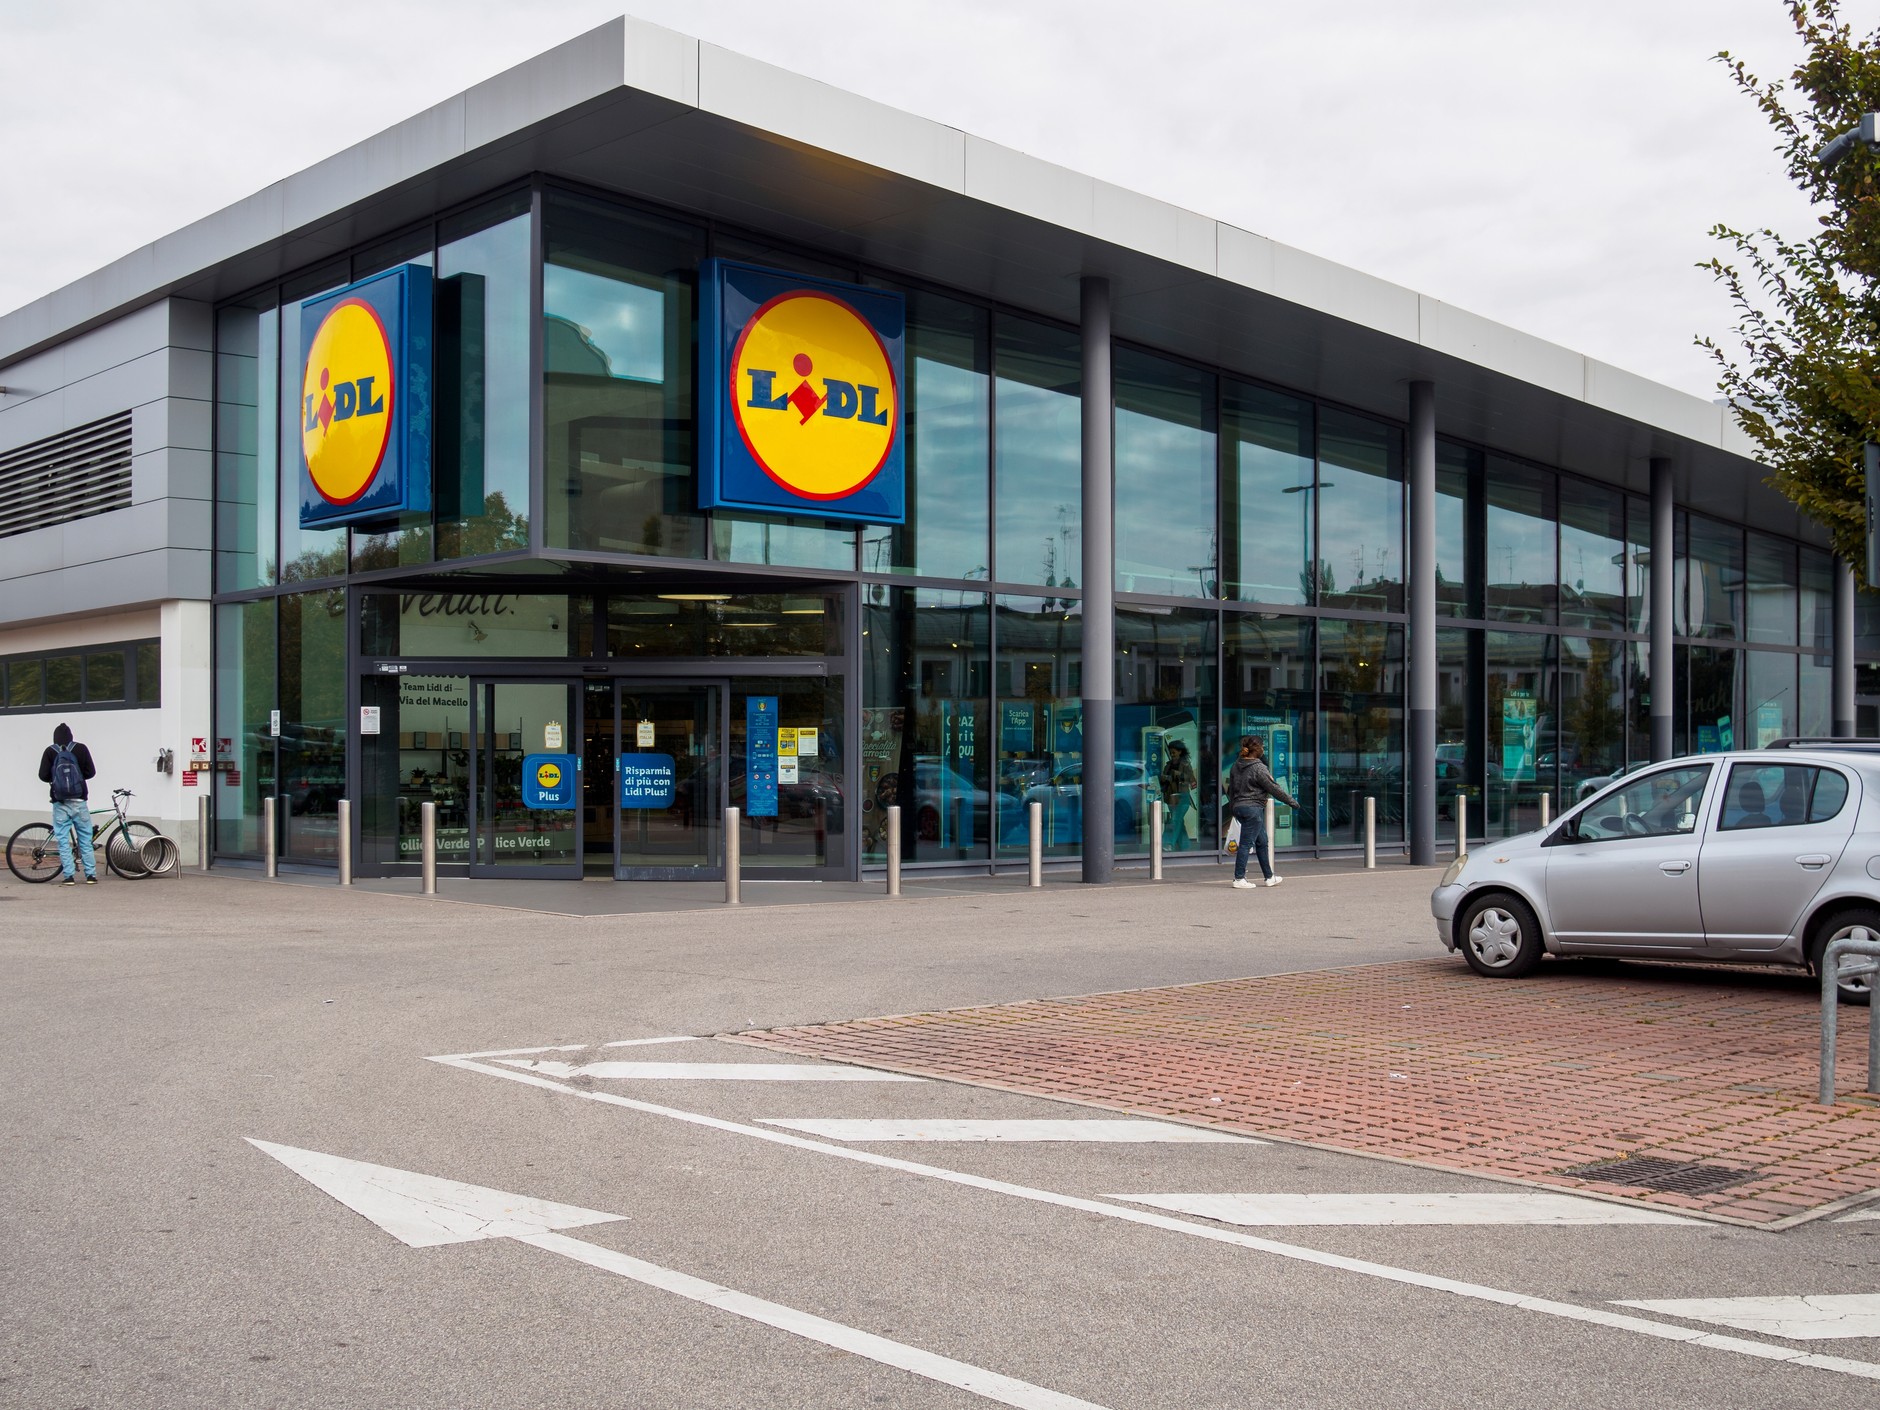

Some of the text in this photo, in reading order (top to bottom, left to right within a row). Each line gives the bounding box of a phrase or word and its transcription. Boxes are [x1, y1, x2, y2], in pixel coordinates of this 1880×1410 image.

[403, 682, 453, 692] Team Lidl di
[400, 696, 469, 707] Via del Macello
[625, 766, 671, 776] Risparmia
[625, 777, 671, 787] di più con
[538, 791, 560, 801] Plus
[625, 787, 668, 797] Lidl Plus!
[400, 836, 550, 851] ollic Verde Plice Verde
